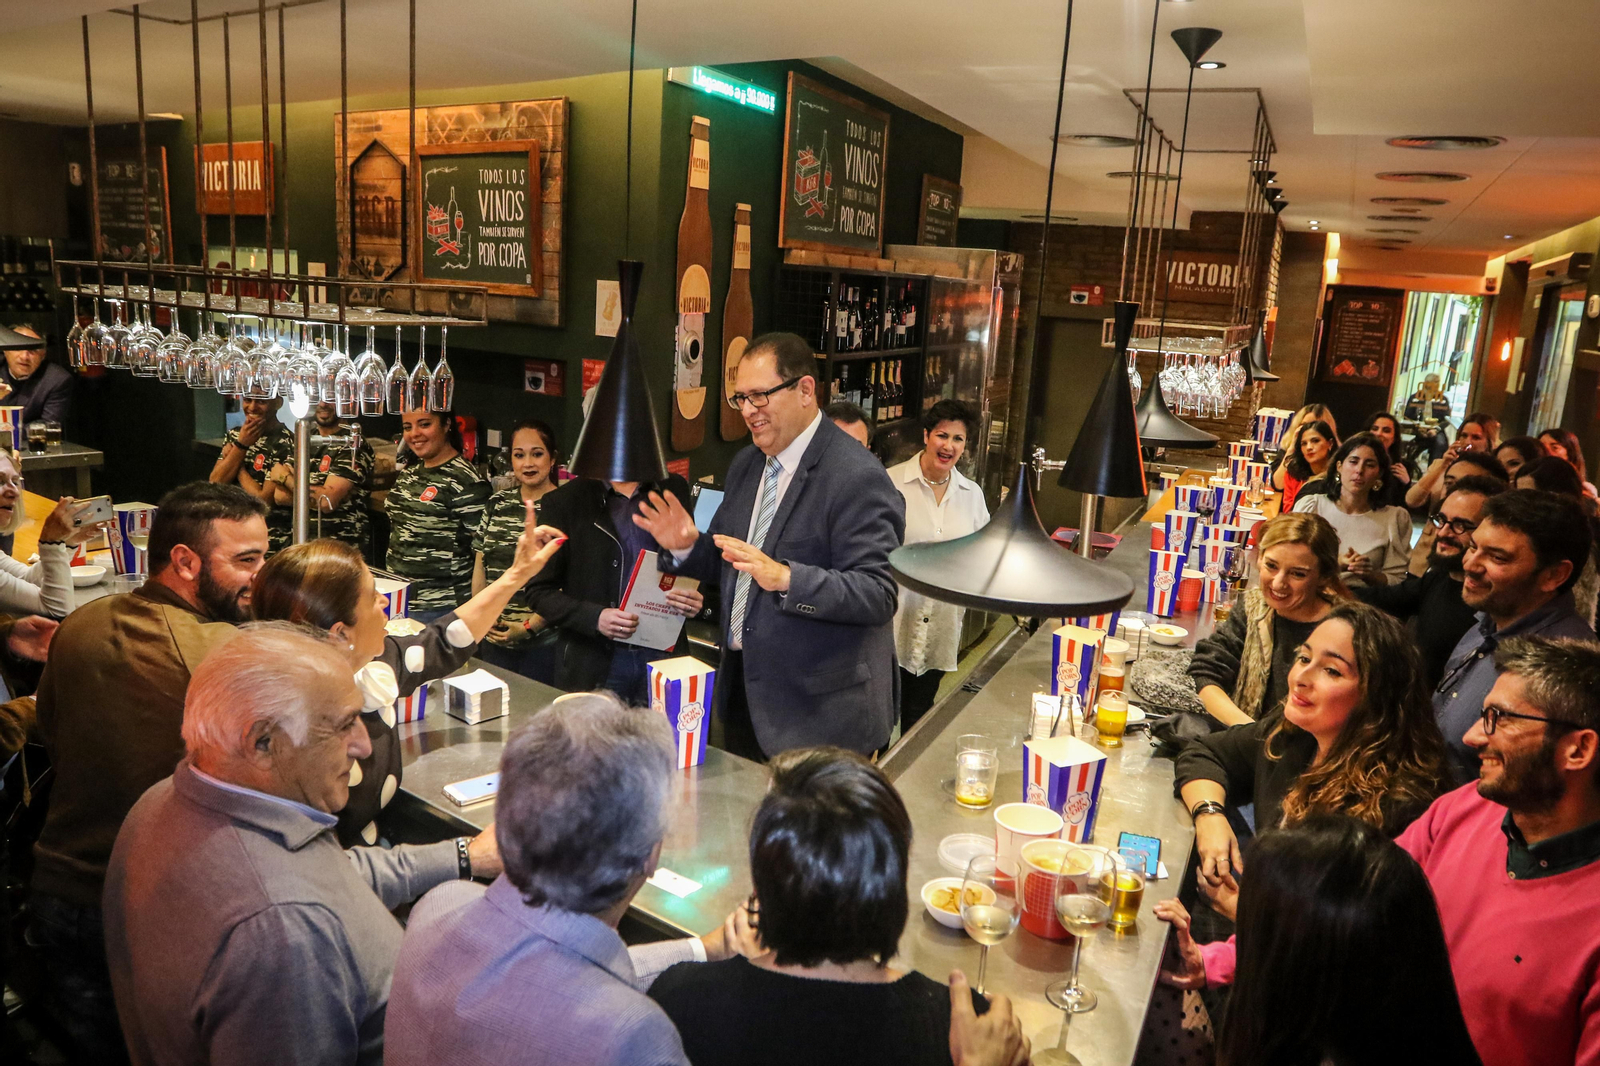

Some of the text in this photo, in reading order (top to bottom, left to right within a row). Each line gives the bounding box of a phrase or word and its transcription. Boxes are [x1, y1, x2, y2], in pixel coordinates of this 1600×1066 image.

[693, 67, 734, 96] Llegamos
[734, 87, 741, 99] a
[846, 118, 882, 148] TODOS LOS
[844, 142, 880, 189] VINOS
[478, 168, 526, 186] TODOS LOS
[478, 188, 526, 222] VINOS
[840, 205, 877, 238] POR COPA
[479, 224, 501, 238] TAMBIÉN
[478, 242, 528, 269] POR COPA
[1060, 673, 1078, 681] CORN
[681, 711, 701, 728] CORN
[682, 706, 697, 720] POP
[1066, 802, 1088, 820] CORN
[1068, 797, 1084, 812] POP
